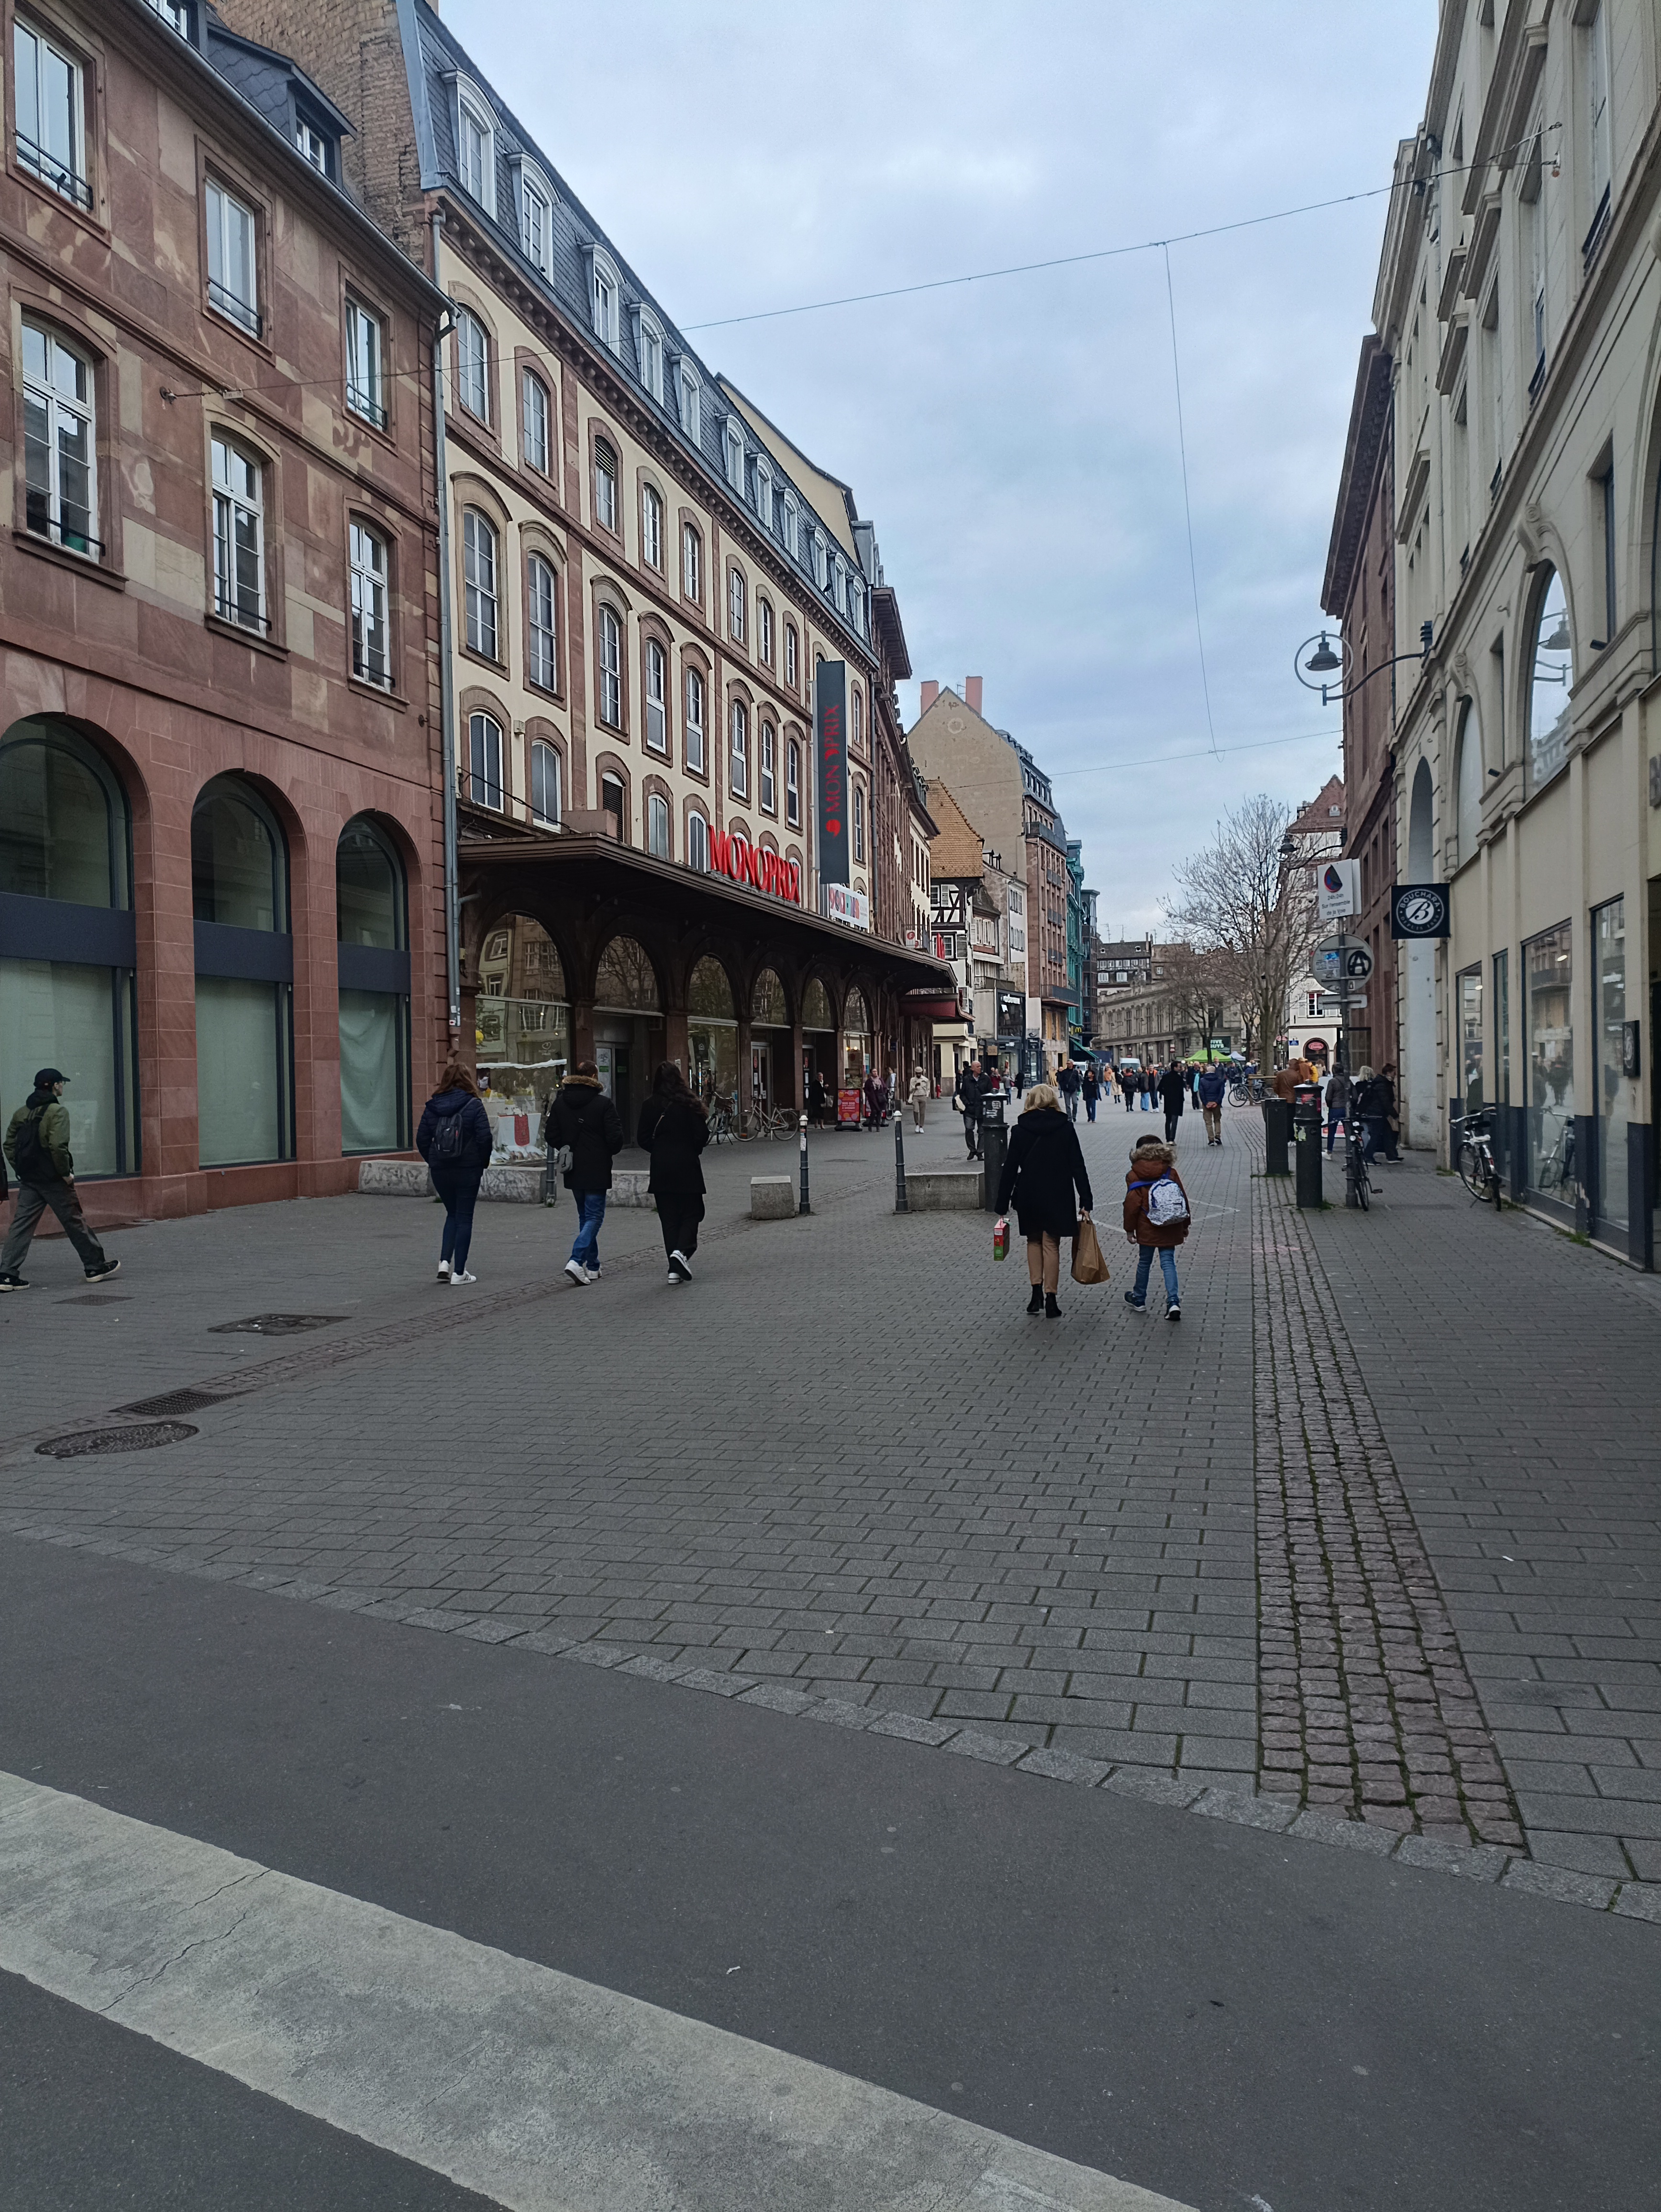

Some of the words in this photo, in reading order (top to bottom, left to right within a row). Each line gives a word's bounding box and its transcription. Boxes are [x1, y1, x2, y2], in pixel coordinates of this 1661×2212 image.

[824, 705, 841, 812] MONOPRIX
[708, 825, 800, 903] MONOPRIX
[1400, 891, 1440, 908] BOUCHARA
